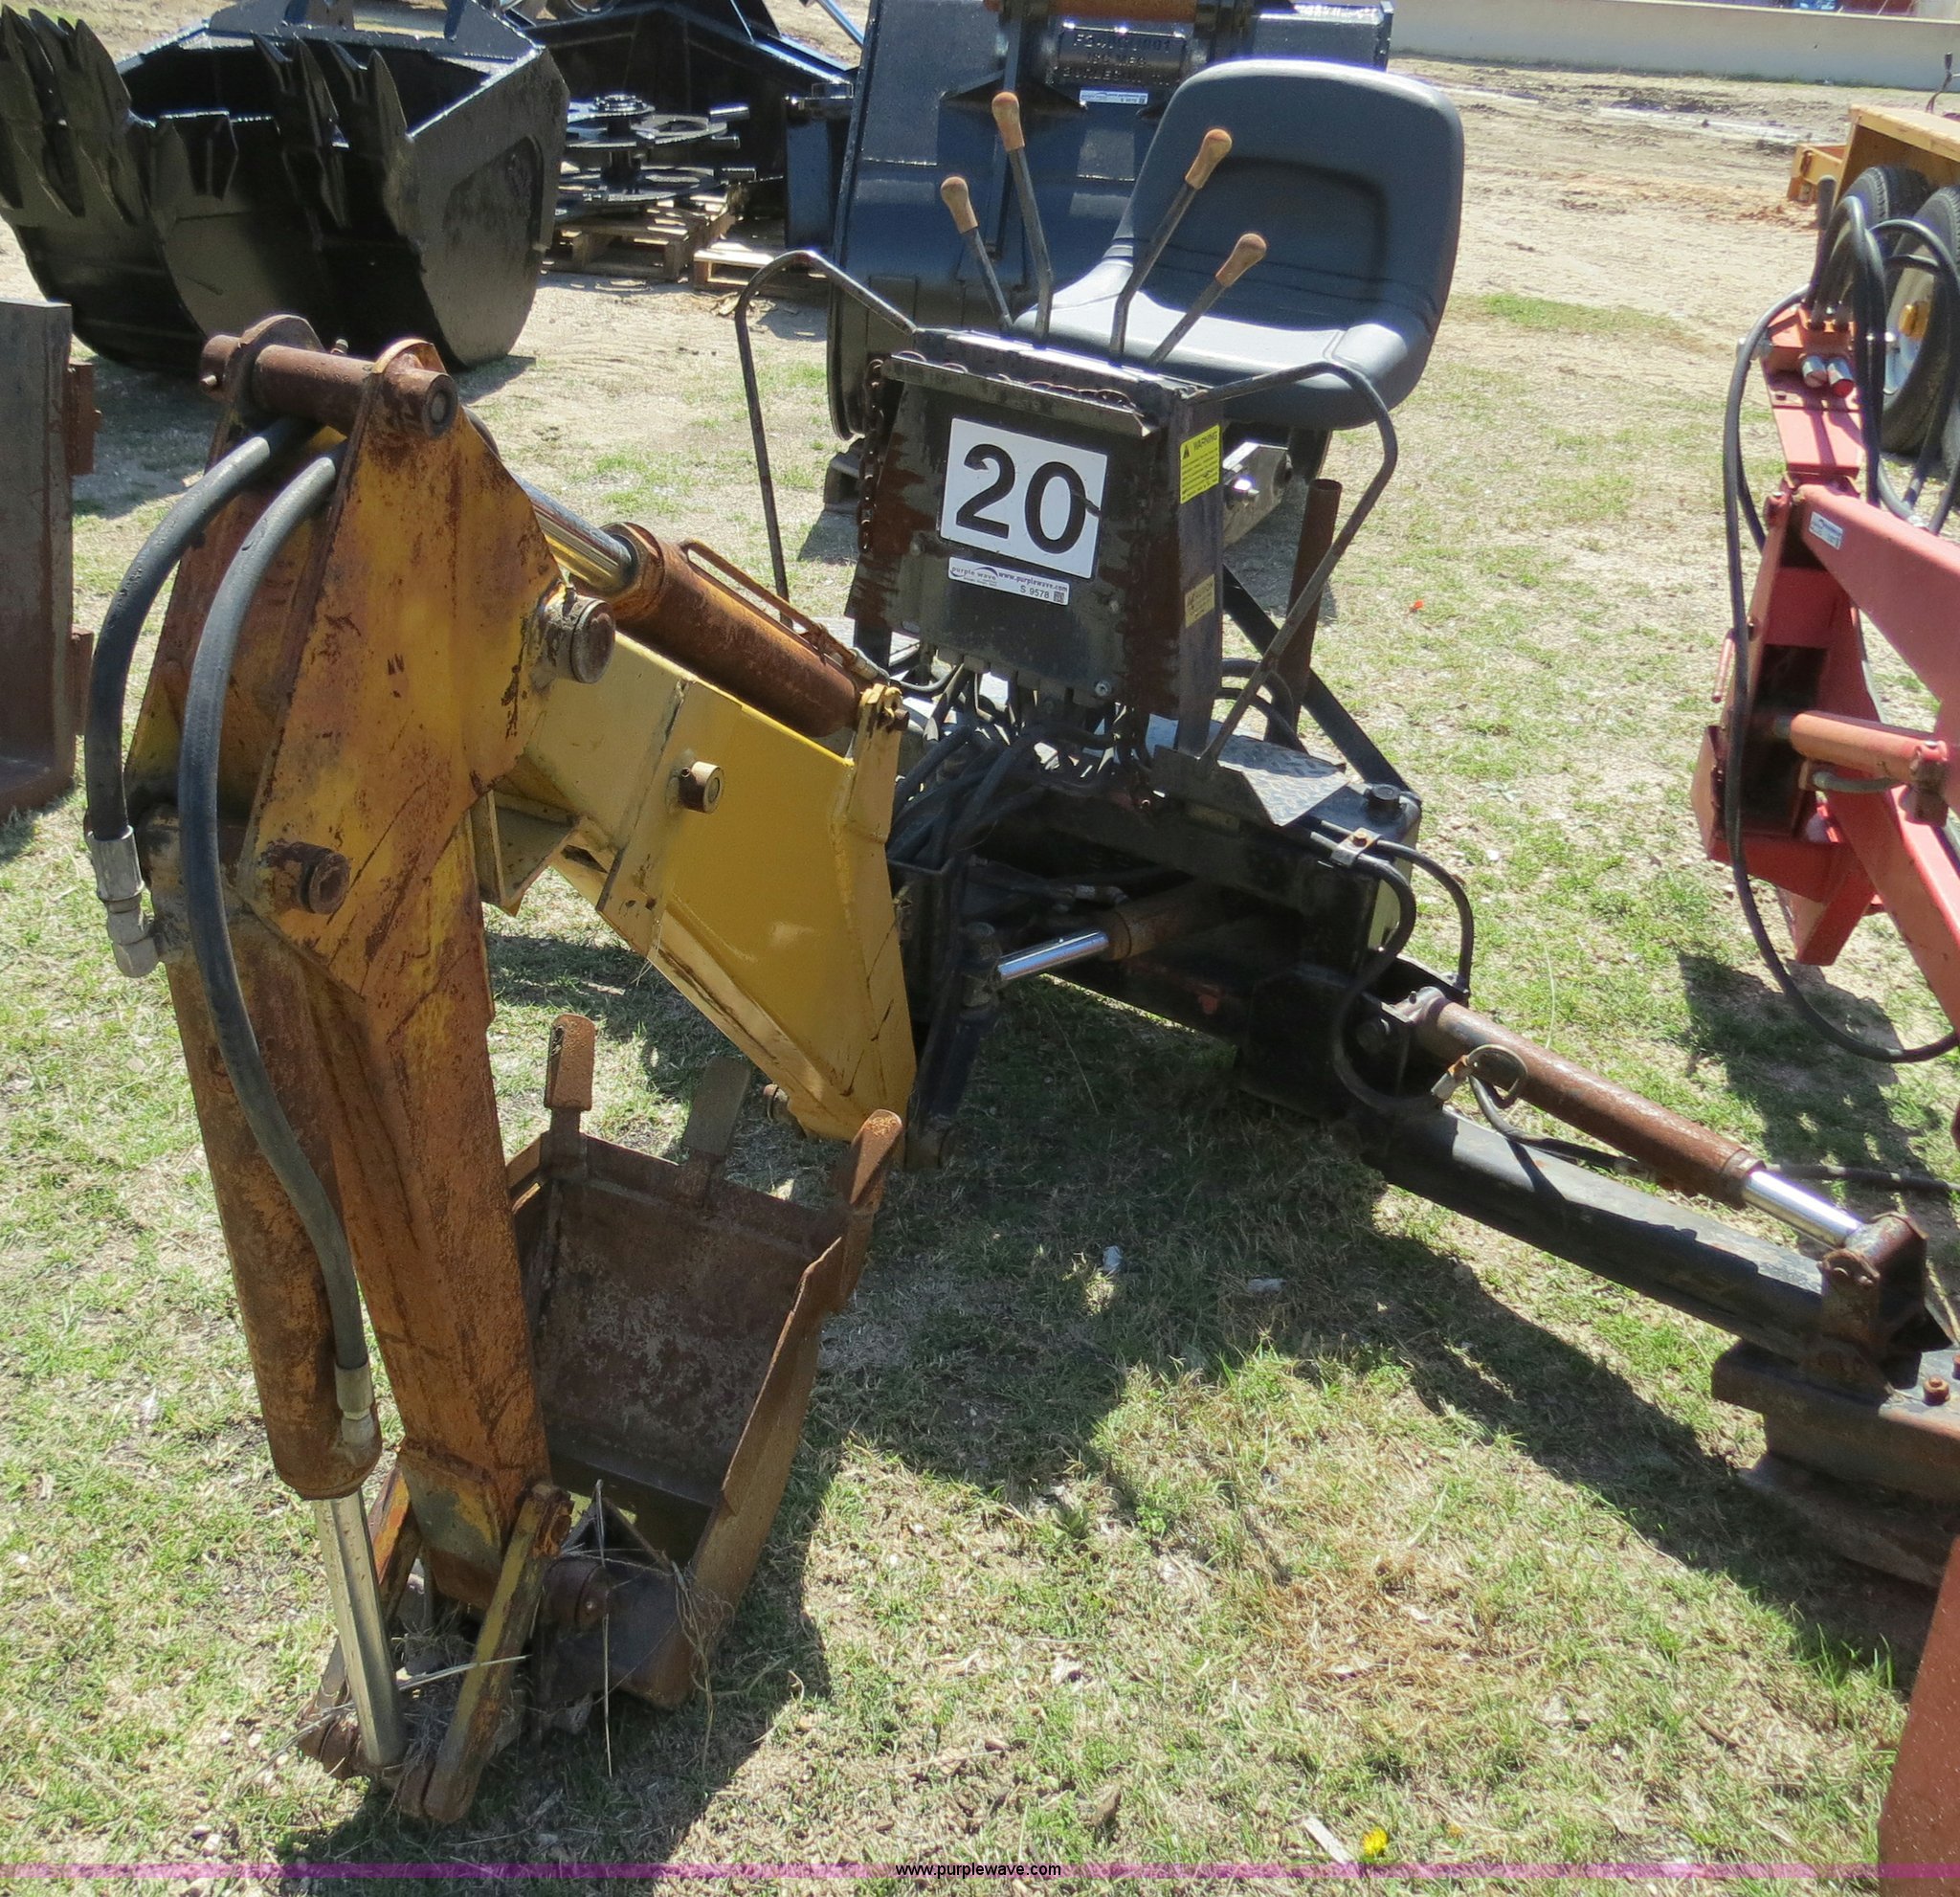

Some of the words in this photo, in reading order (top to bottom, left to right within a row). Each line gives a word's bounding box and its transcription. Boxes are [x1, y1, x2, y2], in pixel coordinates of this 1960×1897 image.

[956, 443, 1086, 554] 20
[951, 566, 975, 576] purple
[977, 572, 996, 581] wave
[998, 571, 1068, 592] www.purplewave.com
[1020, 585, 1027, 593] S
[1029, 587, 1050, 599] 9578
